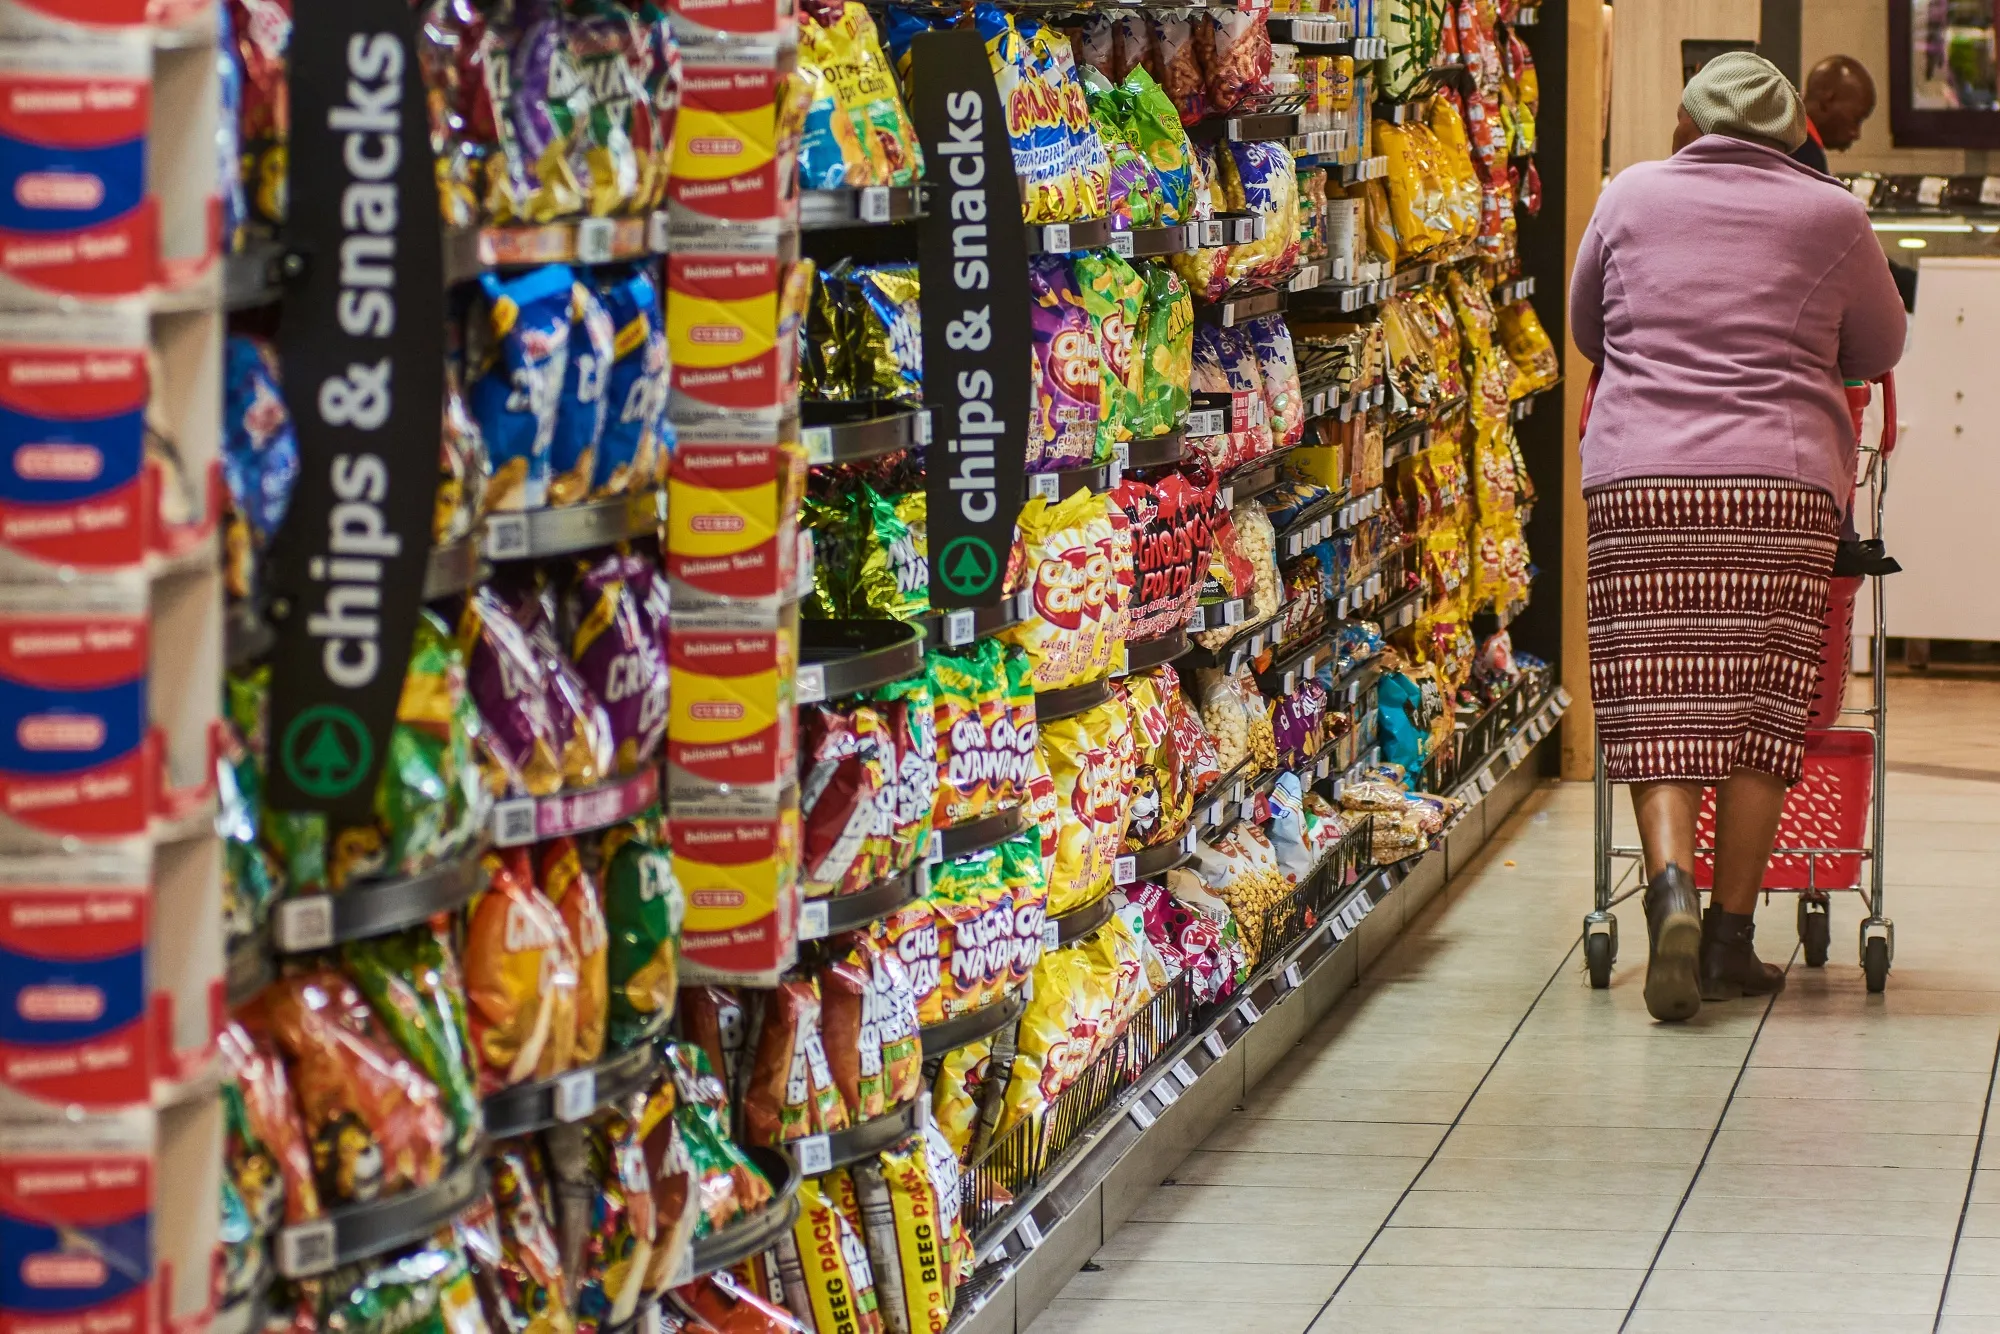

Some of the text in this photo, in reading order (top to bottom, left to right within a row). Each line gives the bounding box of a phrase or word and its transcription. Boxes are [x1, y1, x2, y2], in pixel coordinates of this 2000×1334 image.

[937, 89, 1006, 523] chips & snacks
[308, 32, 404, 688] chips & snacks
[1138, 881, 1154, 904] utney
[899, 1167, 928, 1218] PACK
[809, 1206, 839, 1273] PACK
[915, 1223, 938, 1284] BEEG
